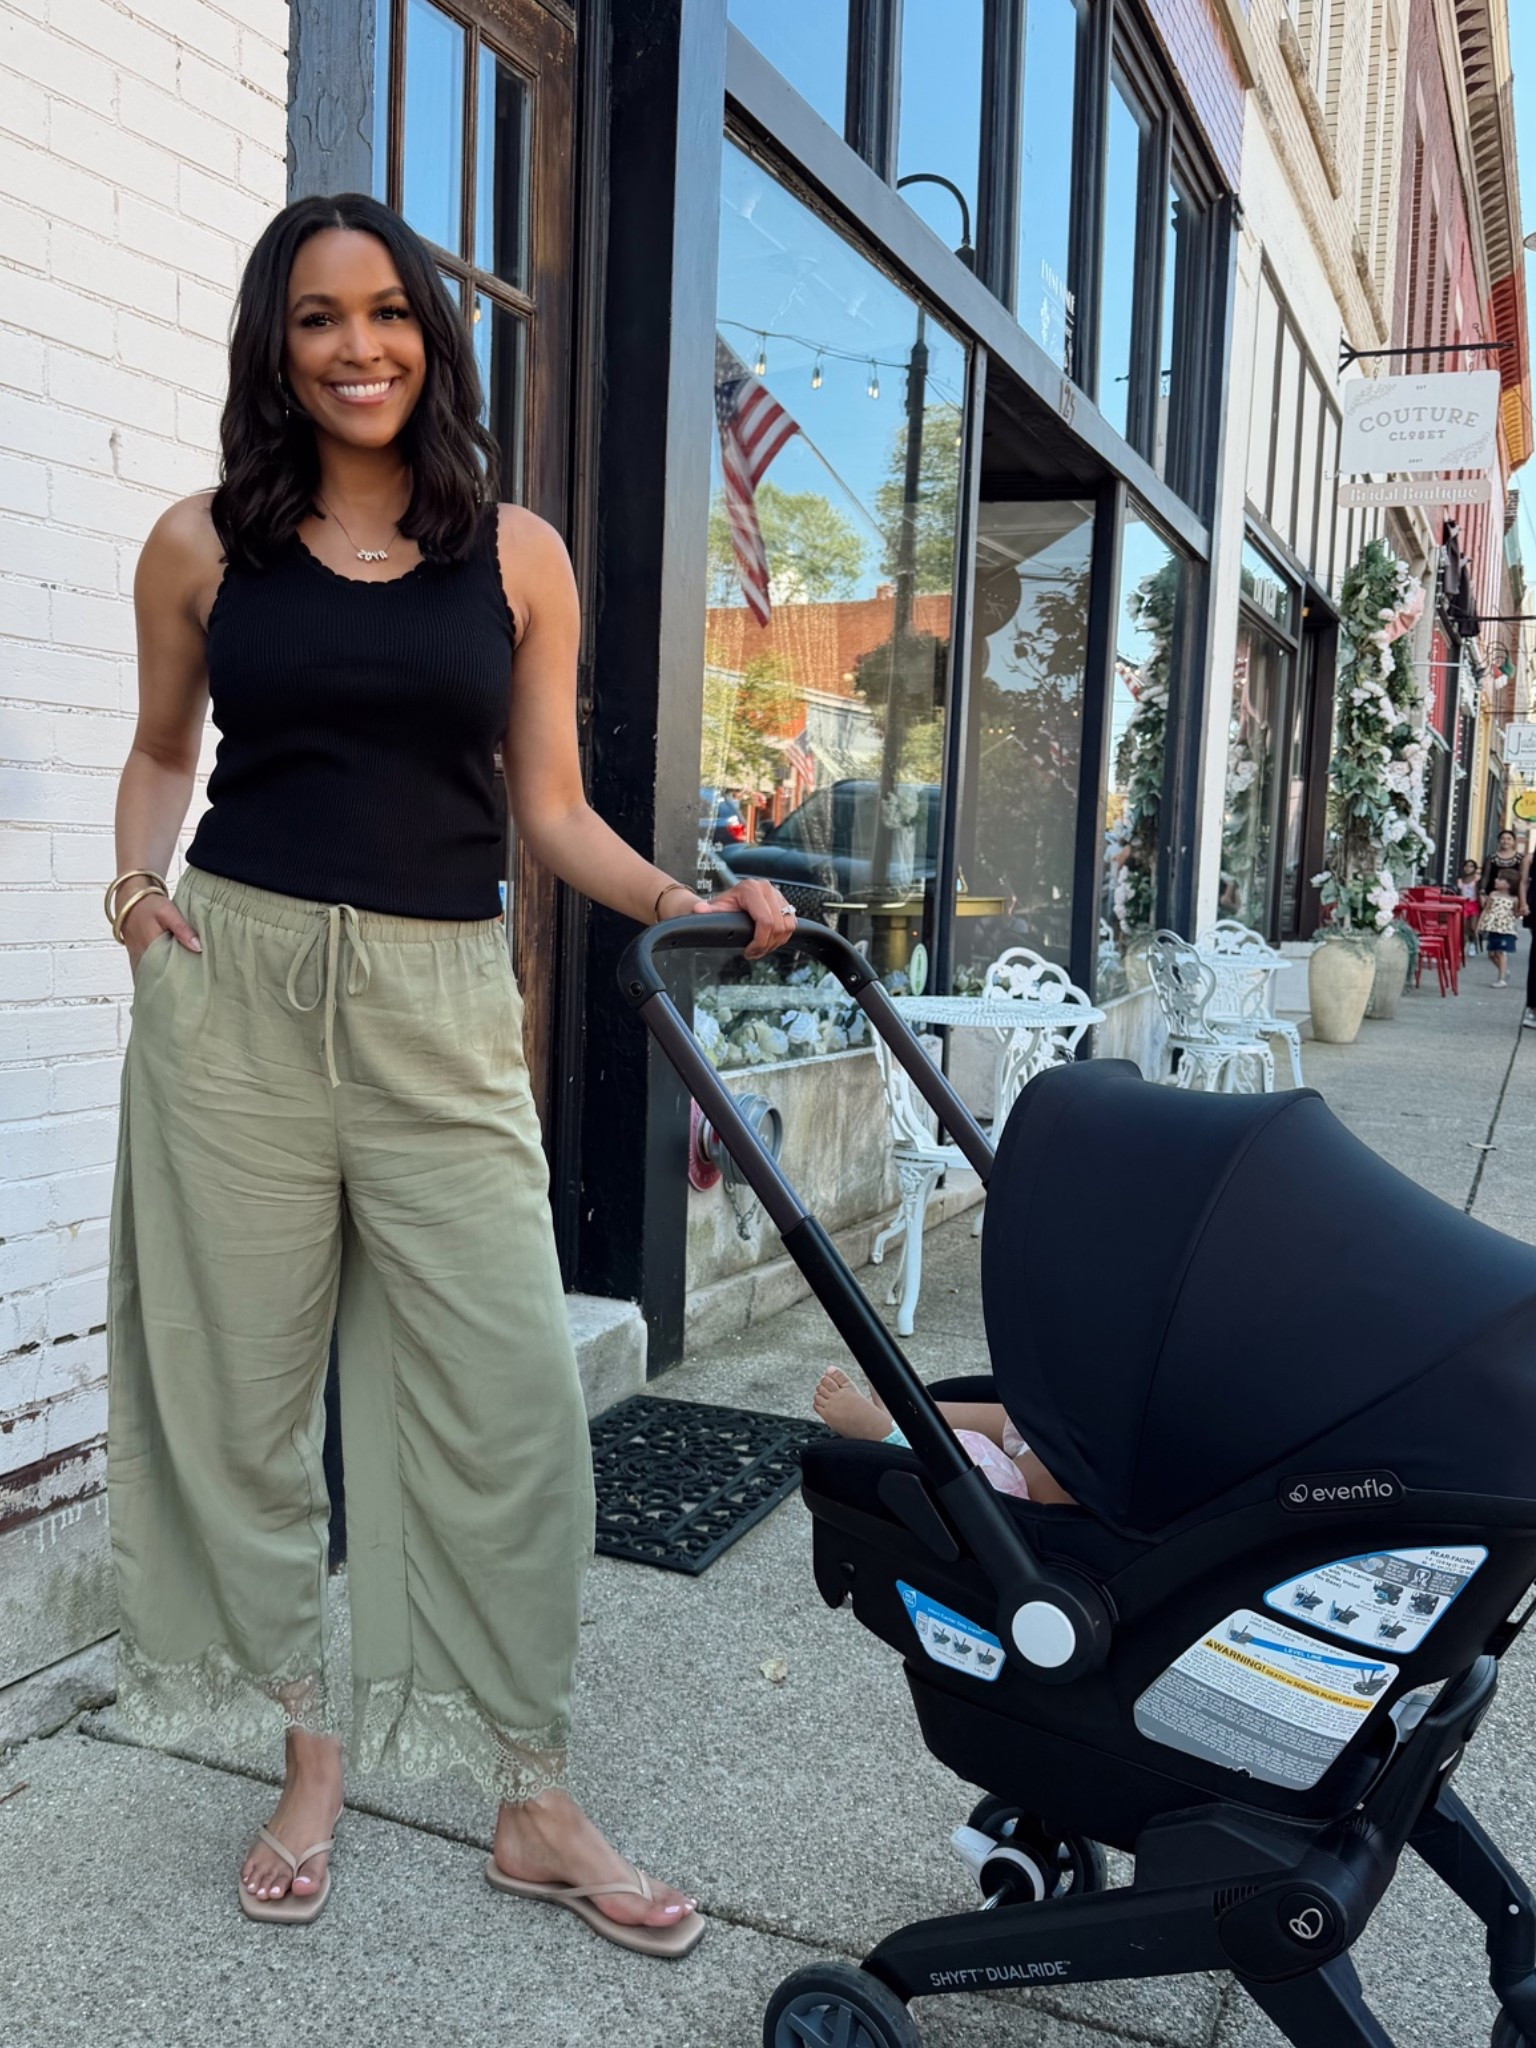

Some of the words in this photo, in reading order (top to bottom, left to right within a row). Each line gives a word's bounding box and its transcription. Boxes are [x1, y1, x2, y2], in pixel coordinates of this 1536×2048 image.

[1359, 406, 1480, 433] COUTURE
[1388, 429, 1447, 442] CLOSET
[1350, 487, 1399, 502] Bridal
[1402, 485, 1478, 503] Boutique
[1312, 1478, 1393, 1502] evenflo
[1212, 1640, 1266, 1673] WARNING!
[1283, 1647, 1306, 1658] LEVEL
